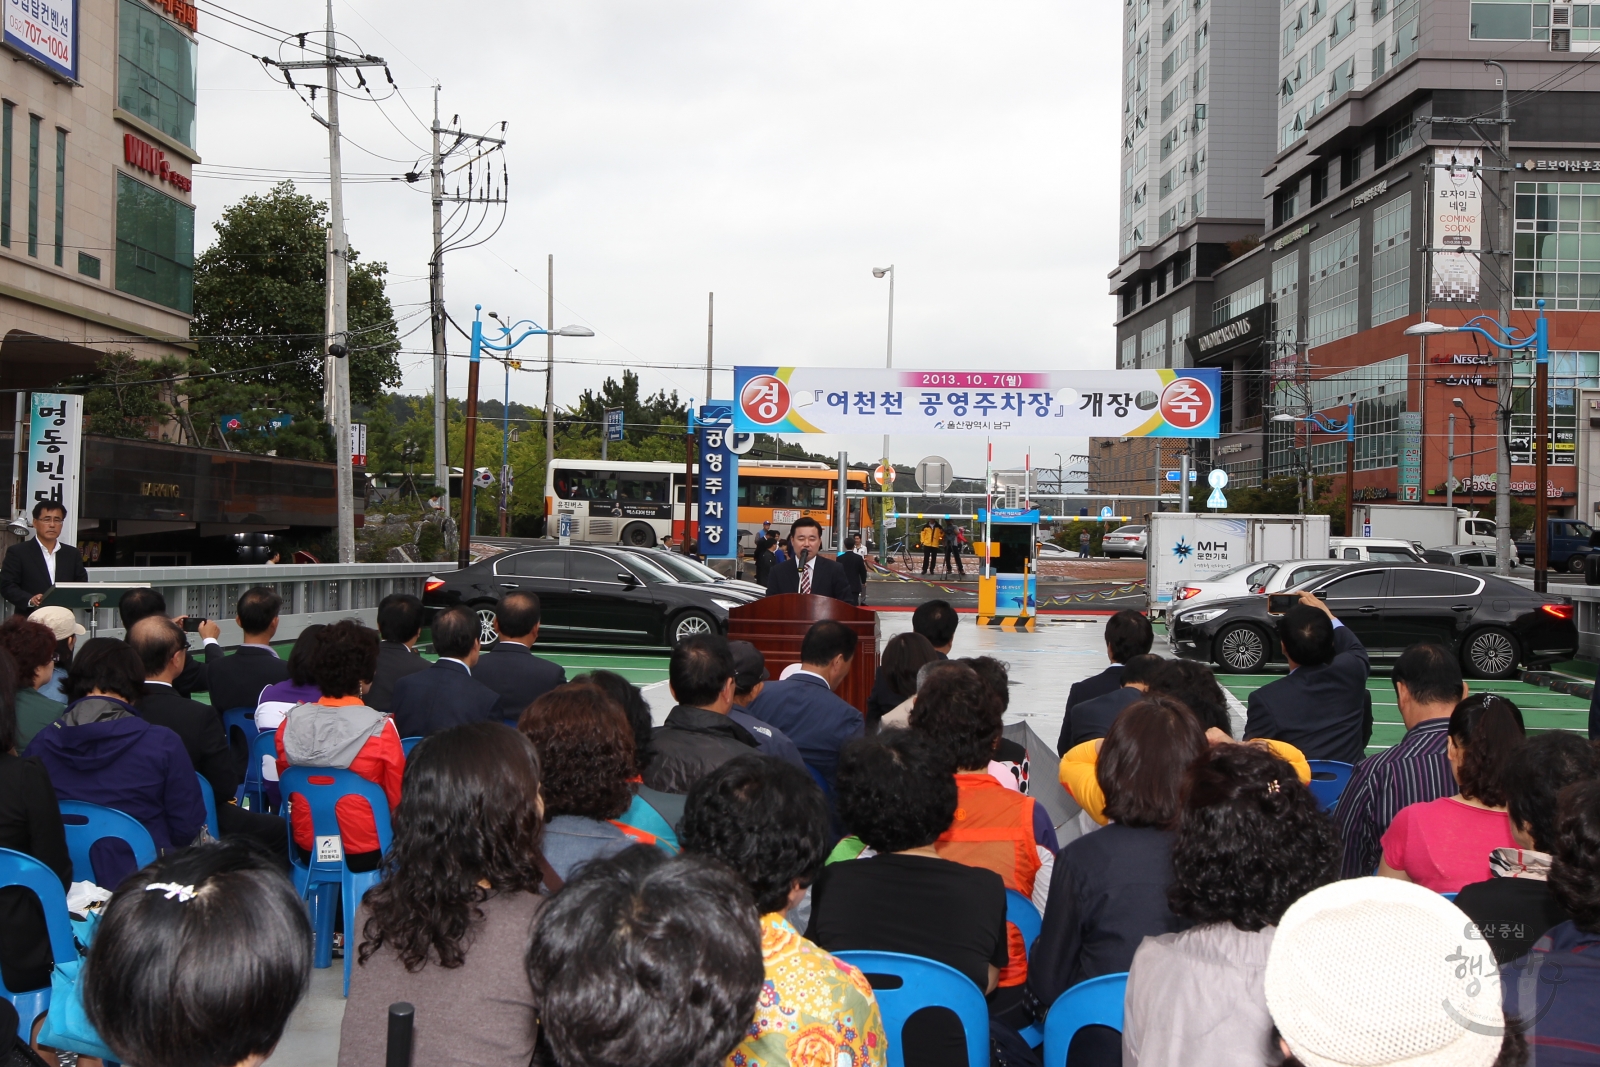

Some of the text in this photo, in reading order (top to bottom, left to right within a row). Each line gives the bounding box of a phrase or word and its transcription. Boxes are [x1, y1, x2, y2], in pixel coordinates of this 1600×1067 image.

[1439, 190, 1477, 199] 모자이크
[1449, 201, 1468, 212] 네일
[1439, 215, 1476, 223] COMING
[1444, 224, 1471, 232] SOON
[923, 374, 1022, 387] 2013. 10. 7(월)
[748, 382, 780, 419] 경
[1079, 392, 1134, 418] 개장
[1167, 384, 1203, 423] 축
[947, 420, 1011, 430] 울산광역시 남구
[704, 429, 723, 544] 공영주차장
[1461, 477, 1497, 492] Pasta
[557, 501, 584, 509] 유진버스
[1197, 541, 1228, 551] MH
